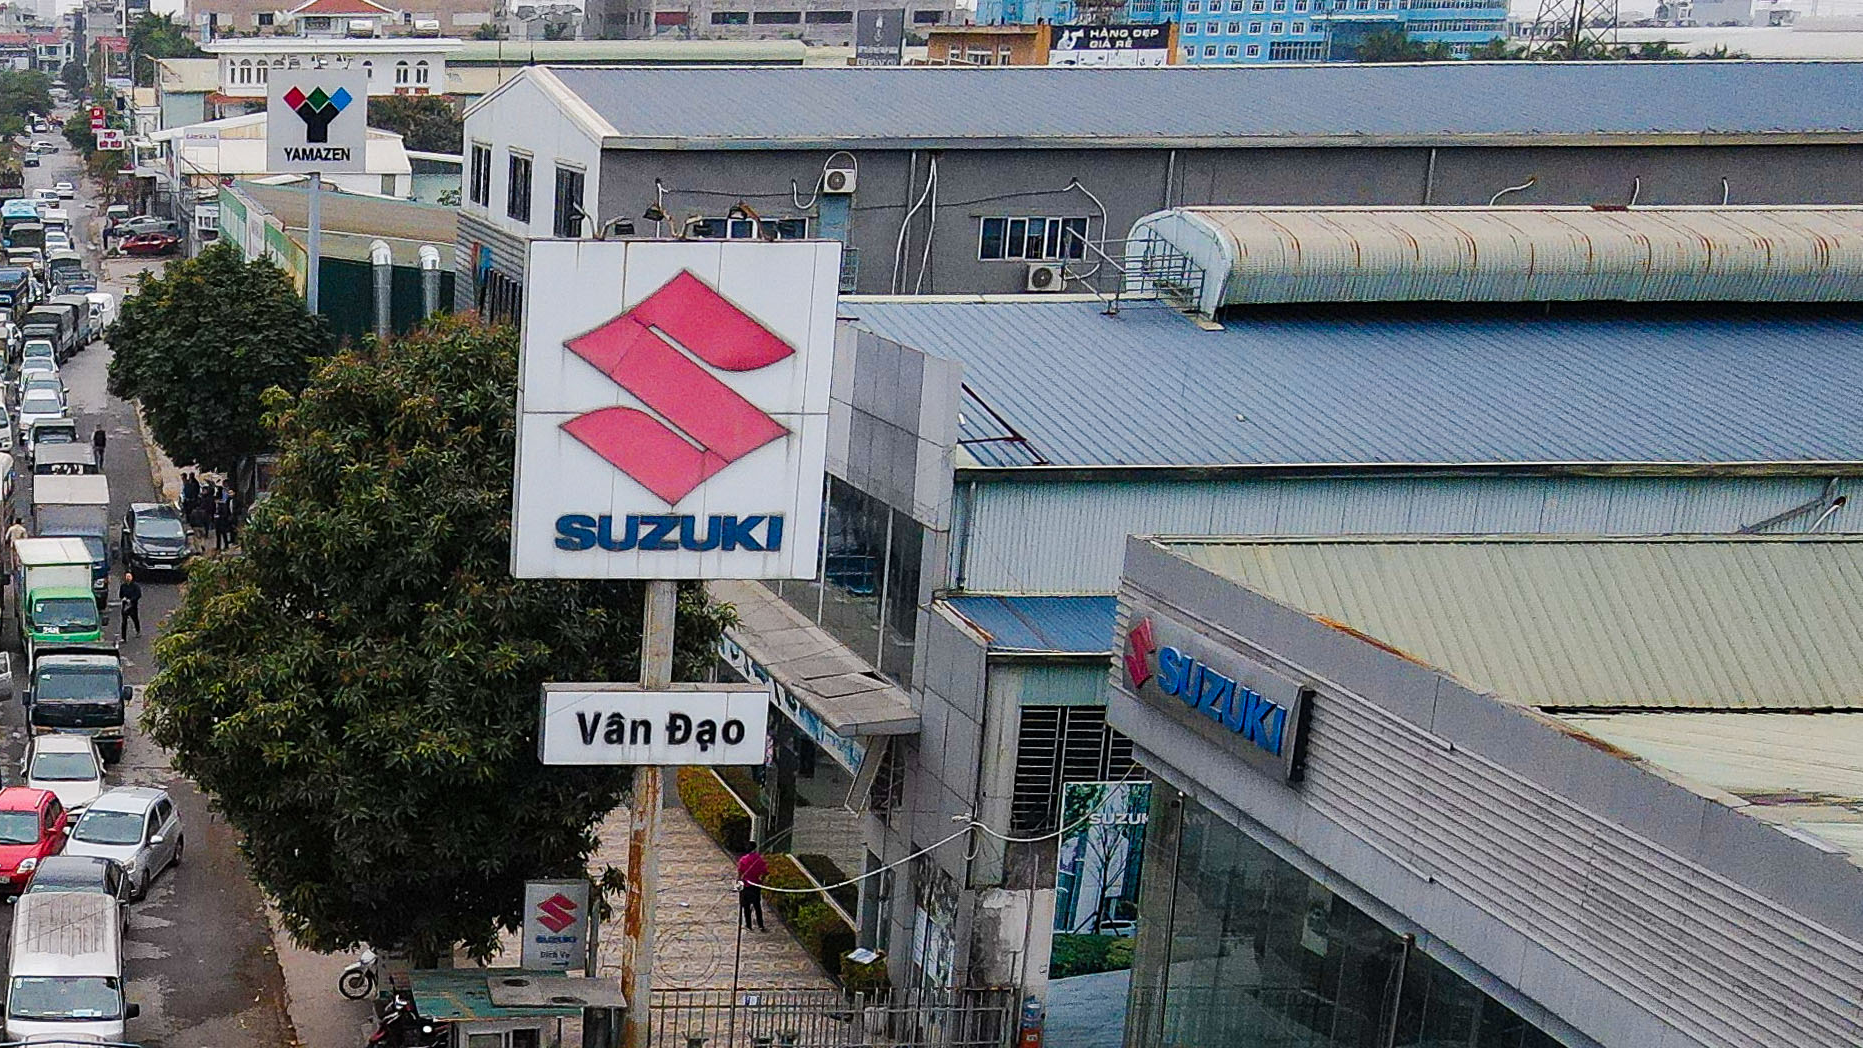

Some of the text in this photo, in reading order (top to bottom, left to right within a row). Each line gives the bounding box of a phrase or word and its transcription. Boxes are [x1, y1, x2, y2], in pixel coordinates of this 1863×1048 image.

[283, 147, 351, 162] YAMAZEN
[554, 514, 785, 551] SUZUKI
[1157, 645, 1287, 757] SUZUKI
[576, 711, 745, 752] Vân Đạo
[1088, 812, 1149, 825] SUZUK
